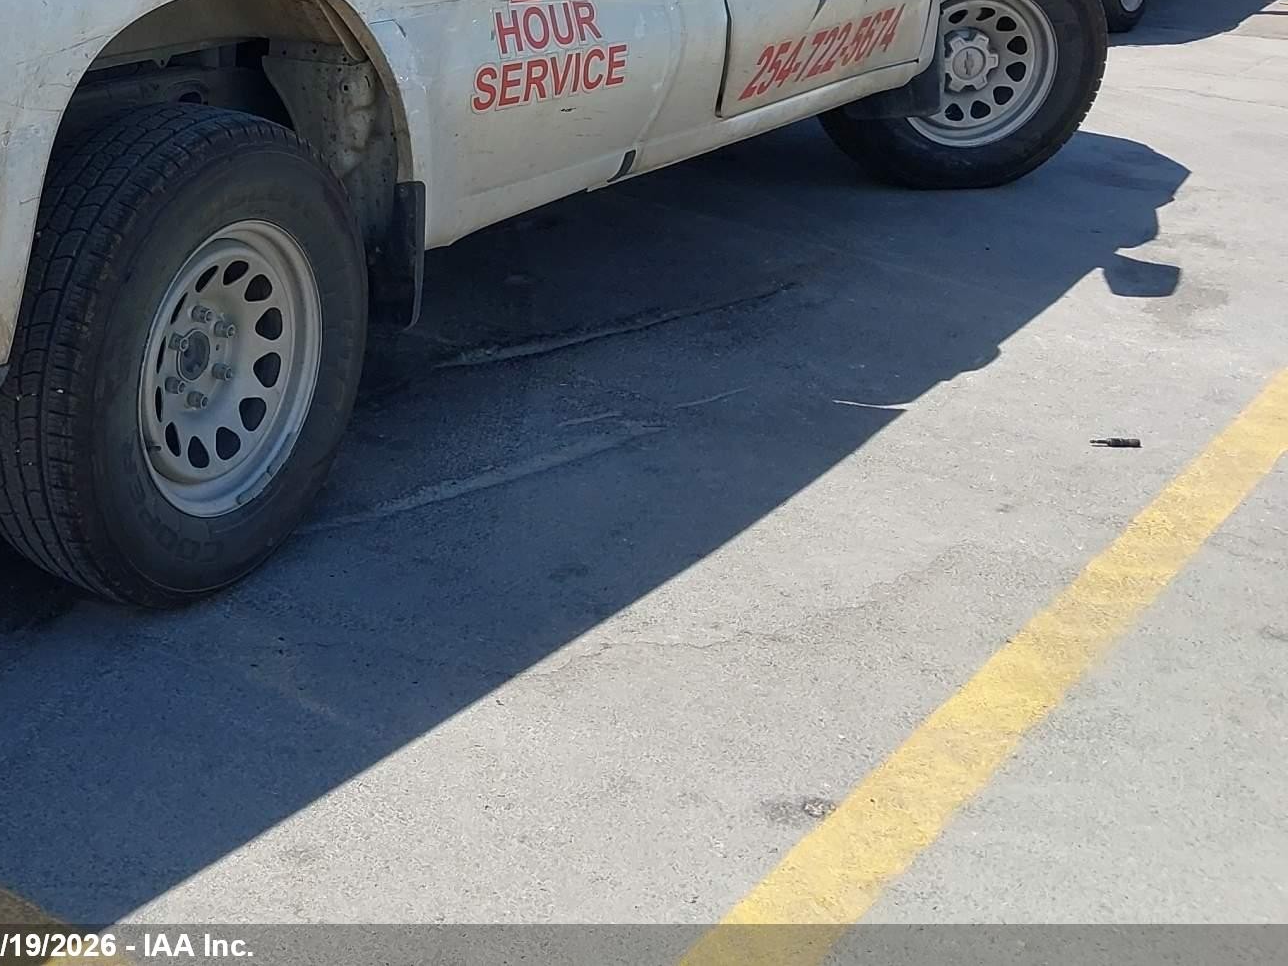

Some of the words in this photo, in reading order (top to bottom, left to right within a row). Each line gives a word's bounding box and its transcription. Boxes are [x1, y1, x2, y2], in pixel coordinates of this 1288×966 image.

[495, 0, 603, 55] HOUR
[738, 2, 906, 101] 254-722-5674
[472, 44, 628, 111] SERVICE
